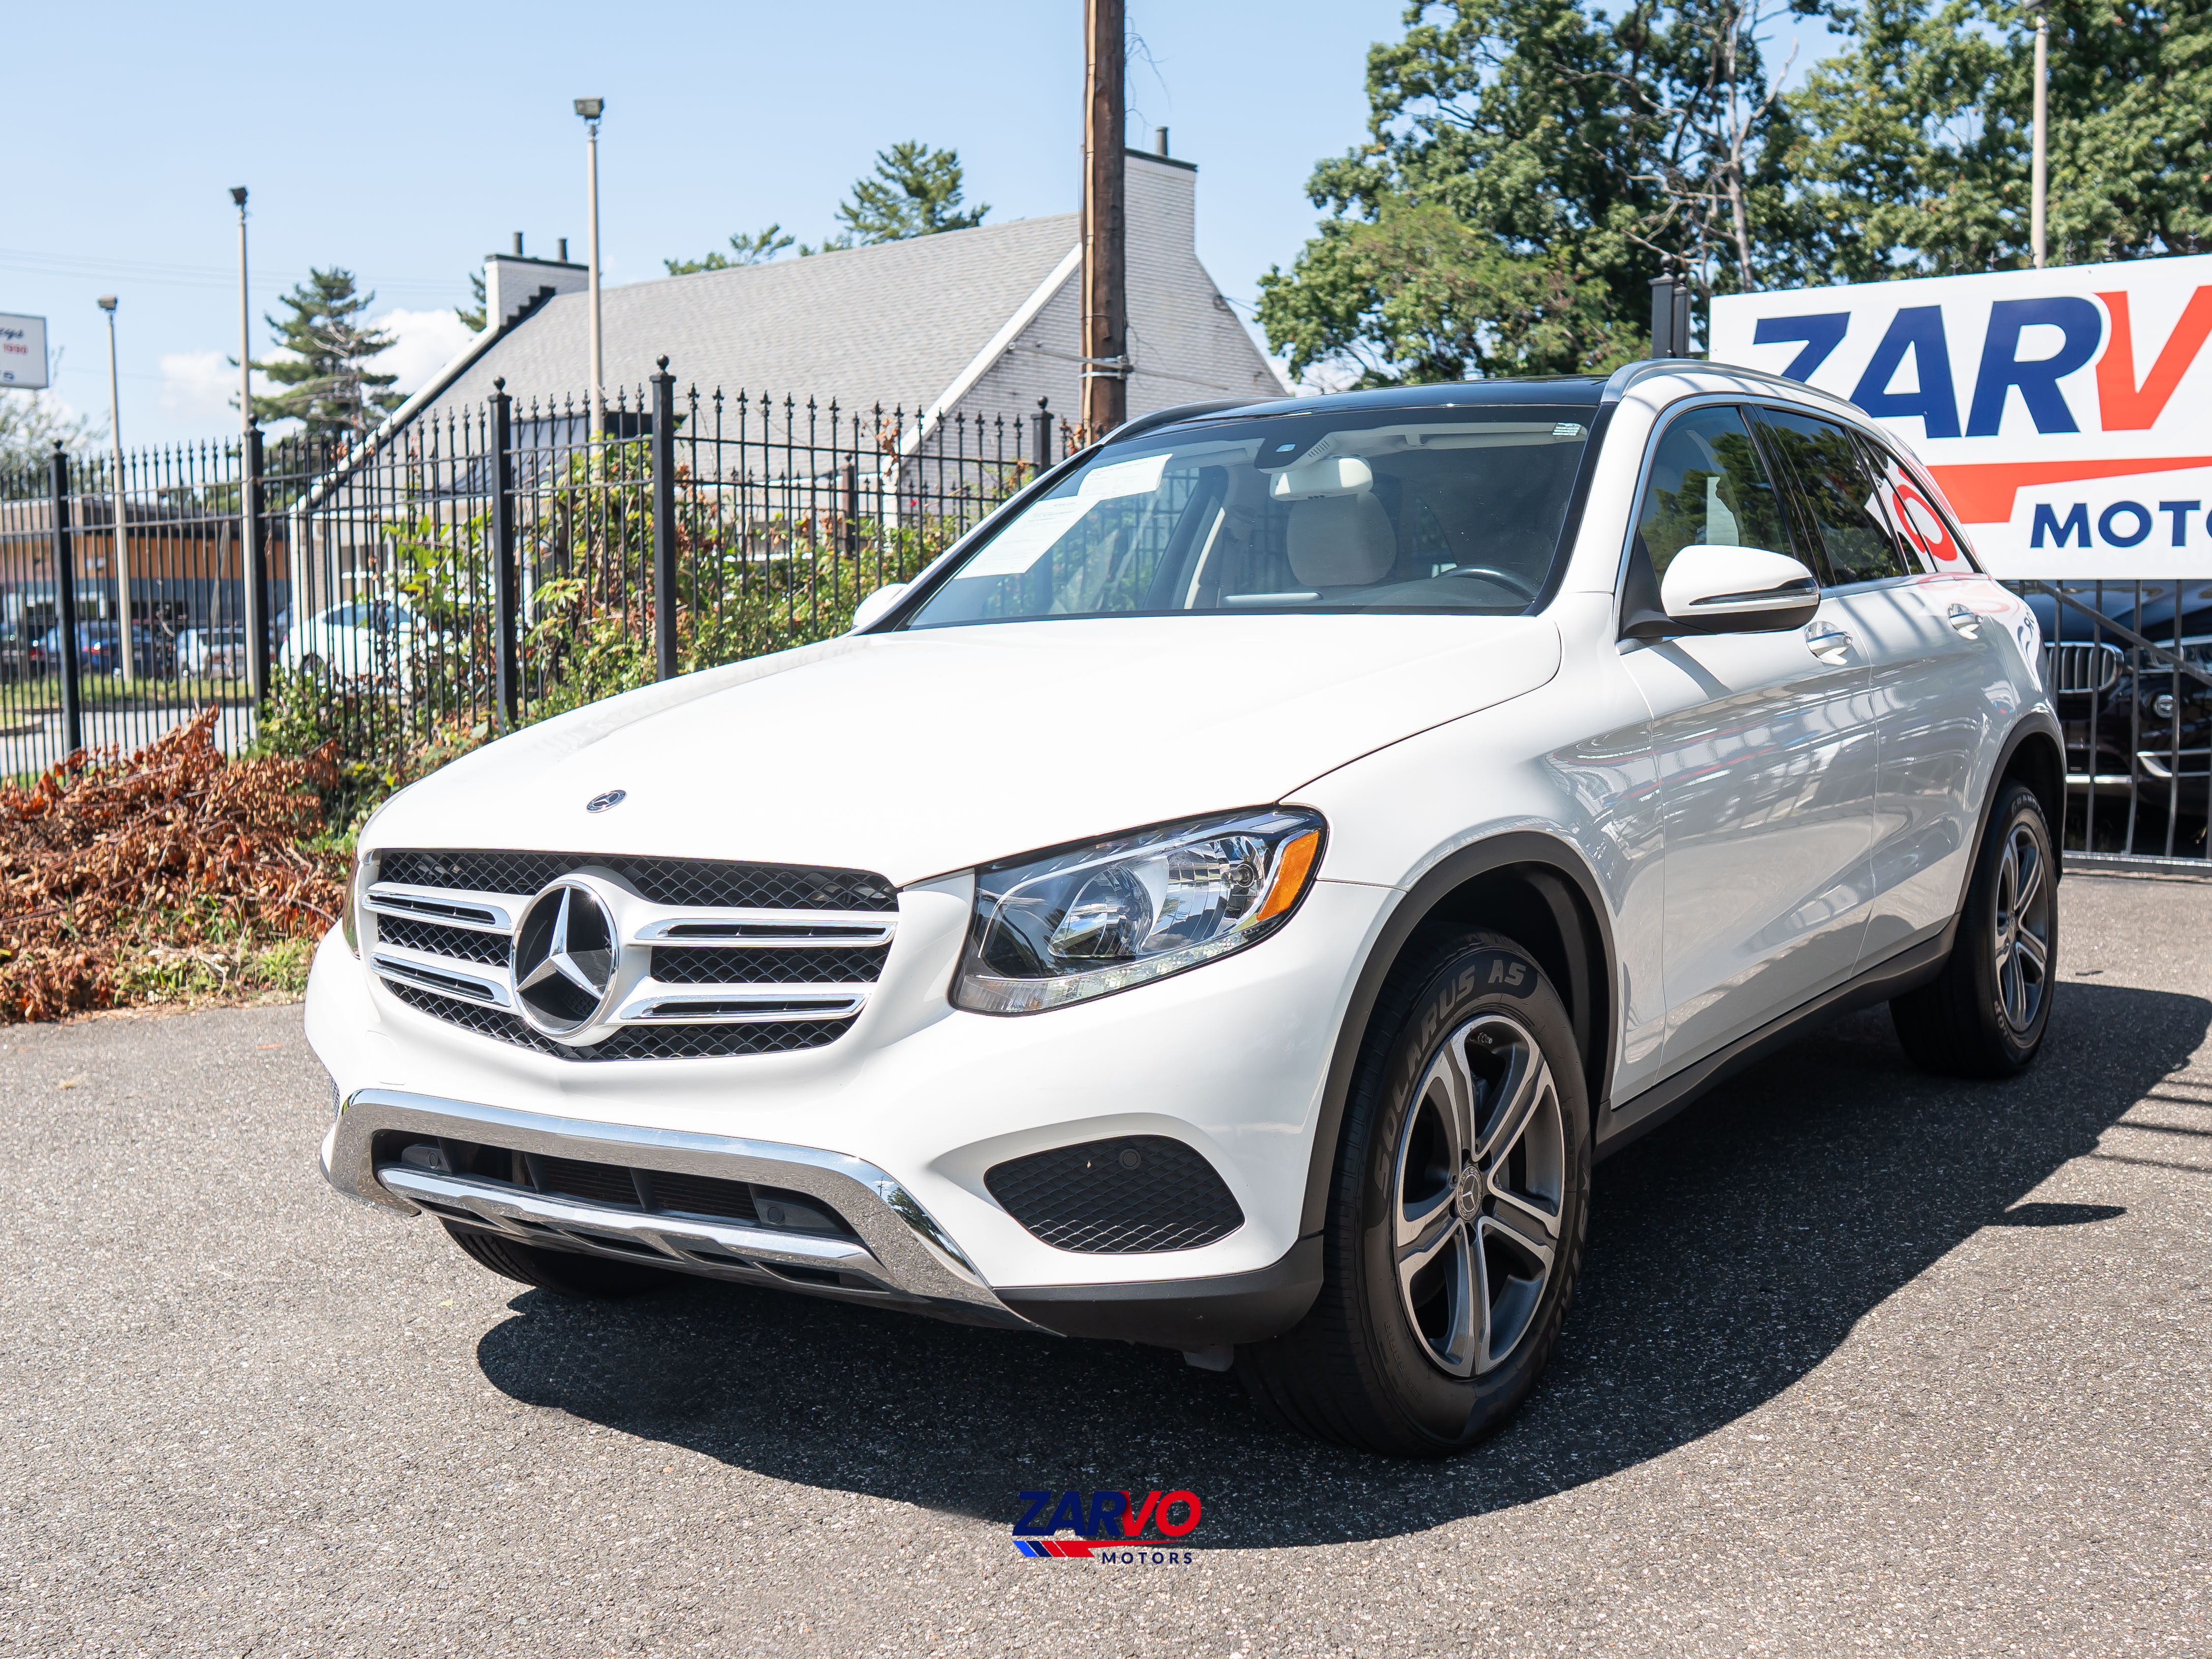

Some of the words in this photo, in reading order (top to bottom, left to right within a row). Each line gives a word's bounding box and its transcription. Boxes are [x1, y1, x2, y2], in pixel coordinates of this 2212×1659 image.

[2030, 500, 2212, 548] MOT
[1374, 965, 1475, 1200] SOLARUS
[1488, 959, 1526, 986] AS
